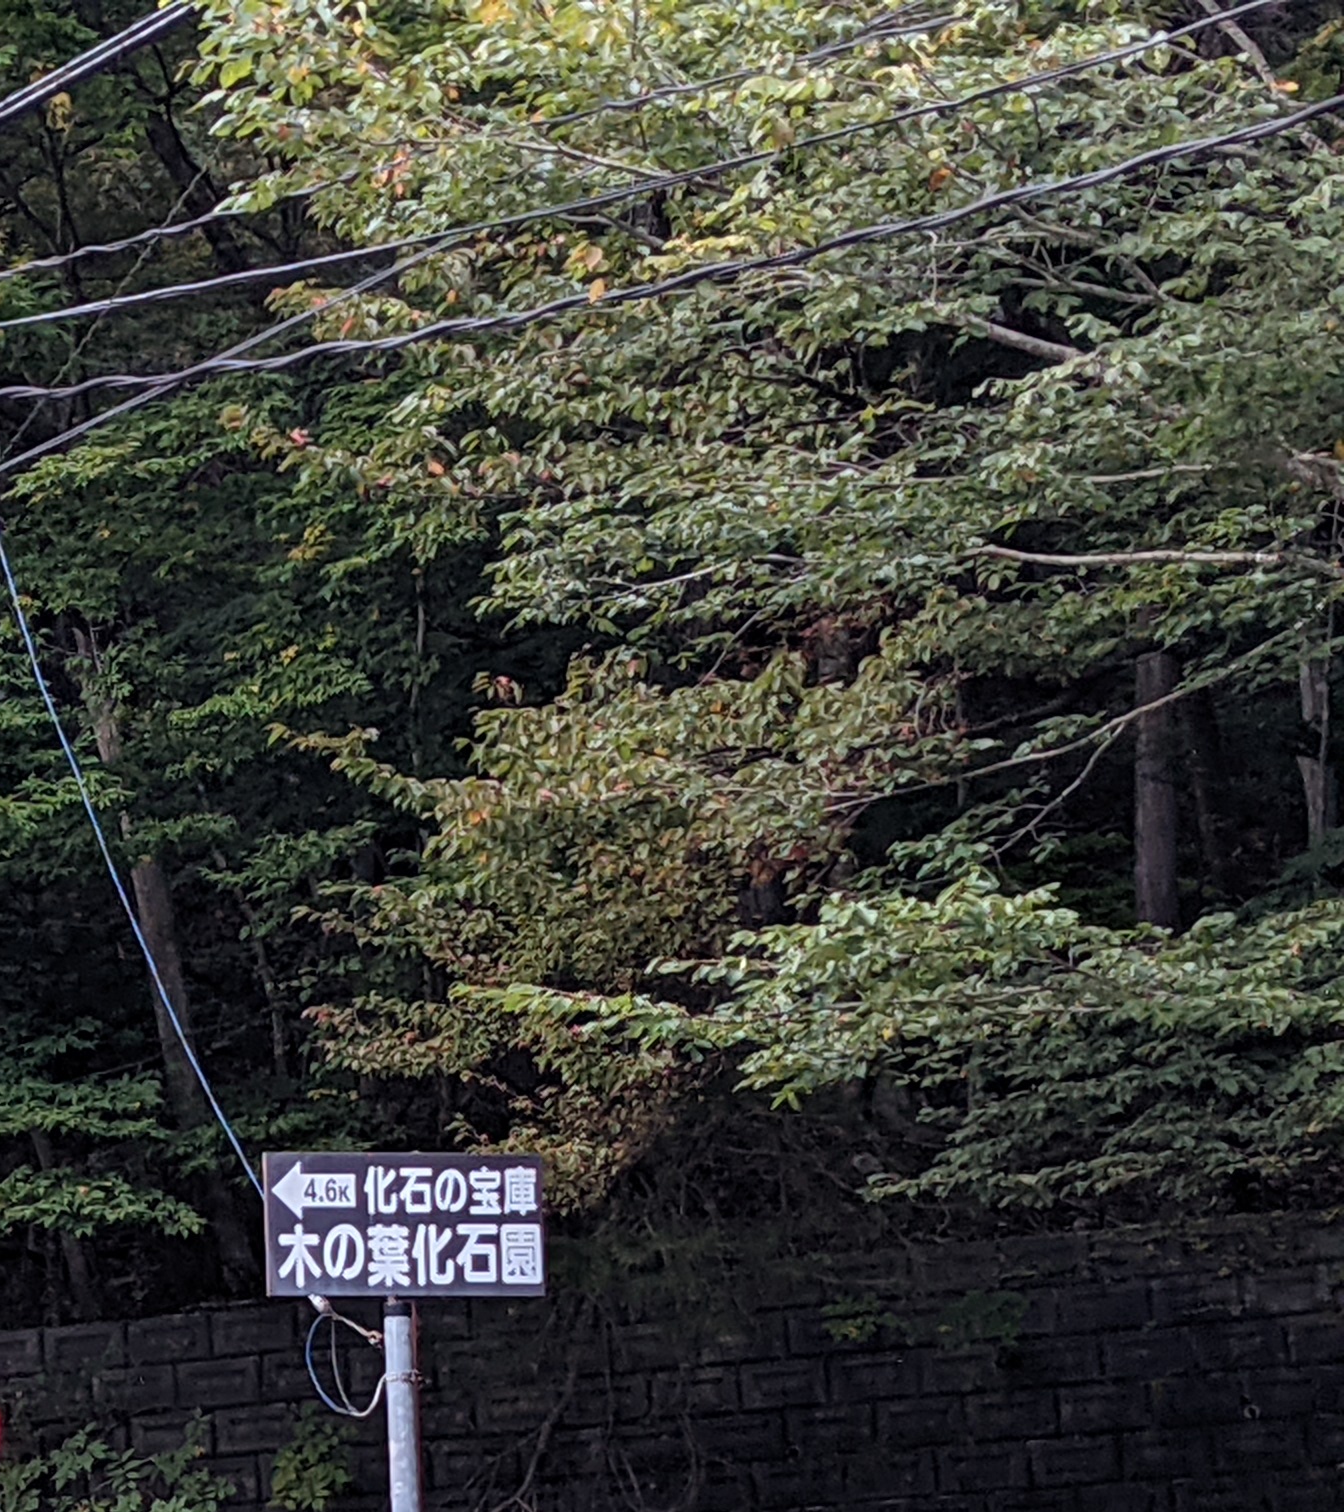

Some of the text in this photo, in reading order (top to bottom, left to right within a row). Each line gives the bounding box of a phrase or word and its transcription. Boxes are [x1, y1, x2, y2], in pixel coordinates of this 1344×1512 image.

[364, 1165, 538, 1216] 化石の宝庫
[278, 1223, 544, 1288] 木の葉化石園
